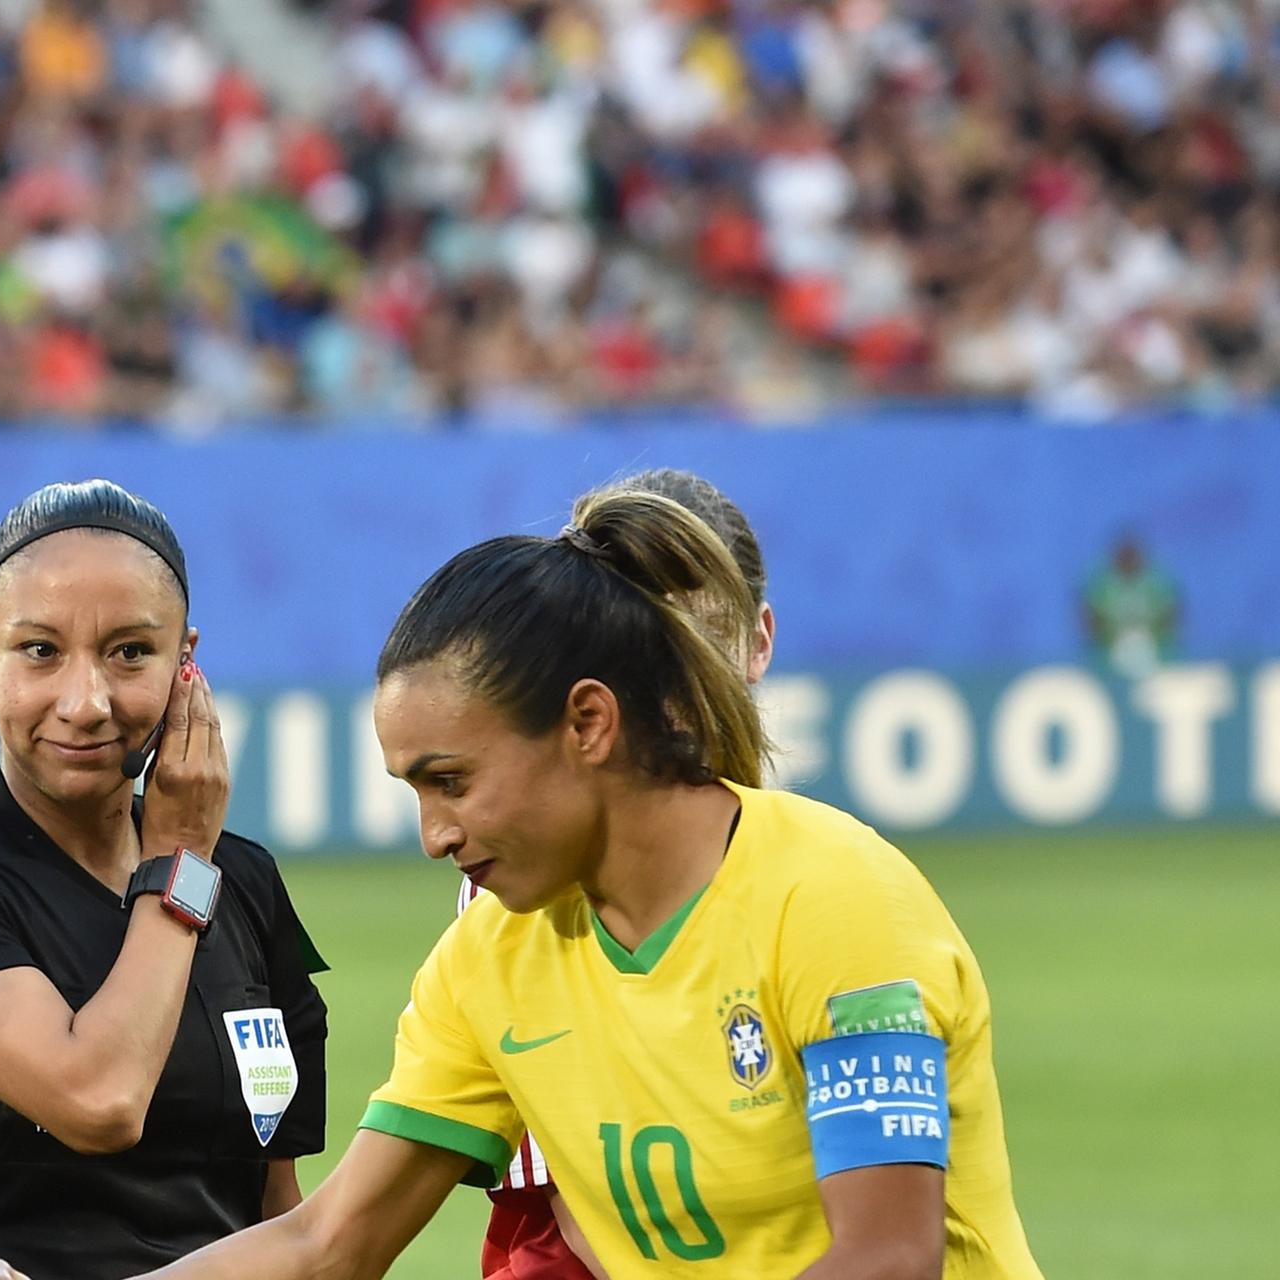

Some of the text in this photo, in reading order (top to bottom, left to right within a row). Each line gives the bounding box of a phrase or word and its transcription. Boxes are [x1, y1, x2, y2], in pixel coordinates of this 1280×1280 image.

[758, 663, 1280, 830] FOOT
[234, 1018, 285, 1049] FIFA
[806, 1055, 936, 1087] LIVING
[253, 1081, 290, 1096] REFEREE
[730, 1091, 784, 1112] BRASIL
[809, 1076, 936, 1108] FOOTBALL
[881, 1114, 943, 1138] FIFA
[598, 1122, 725, 1261] 10
